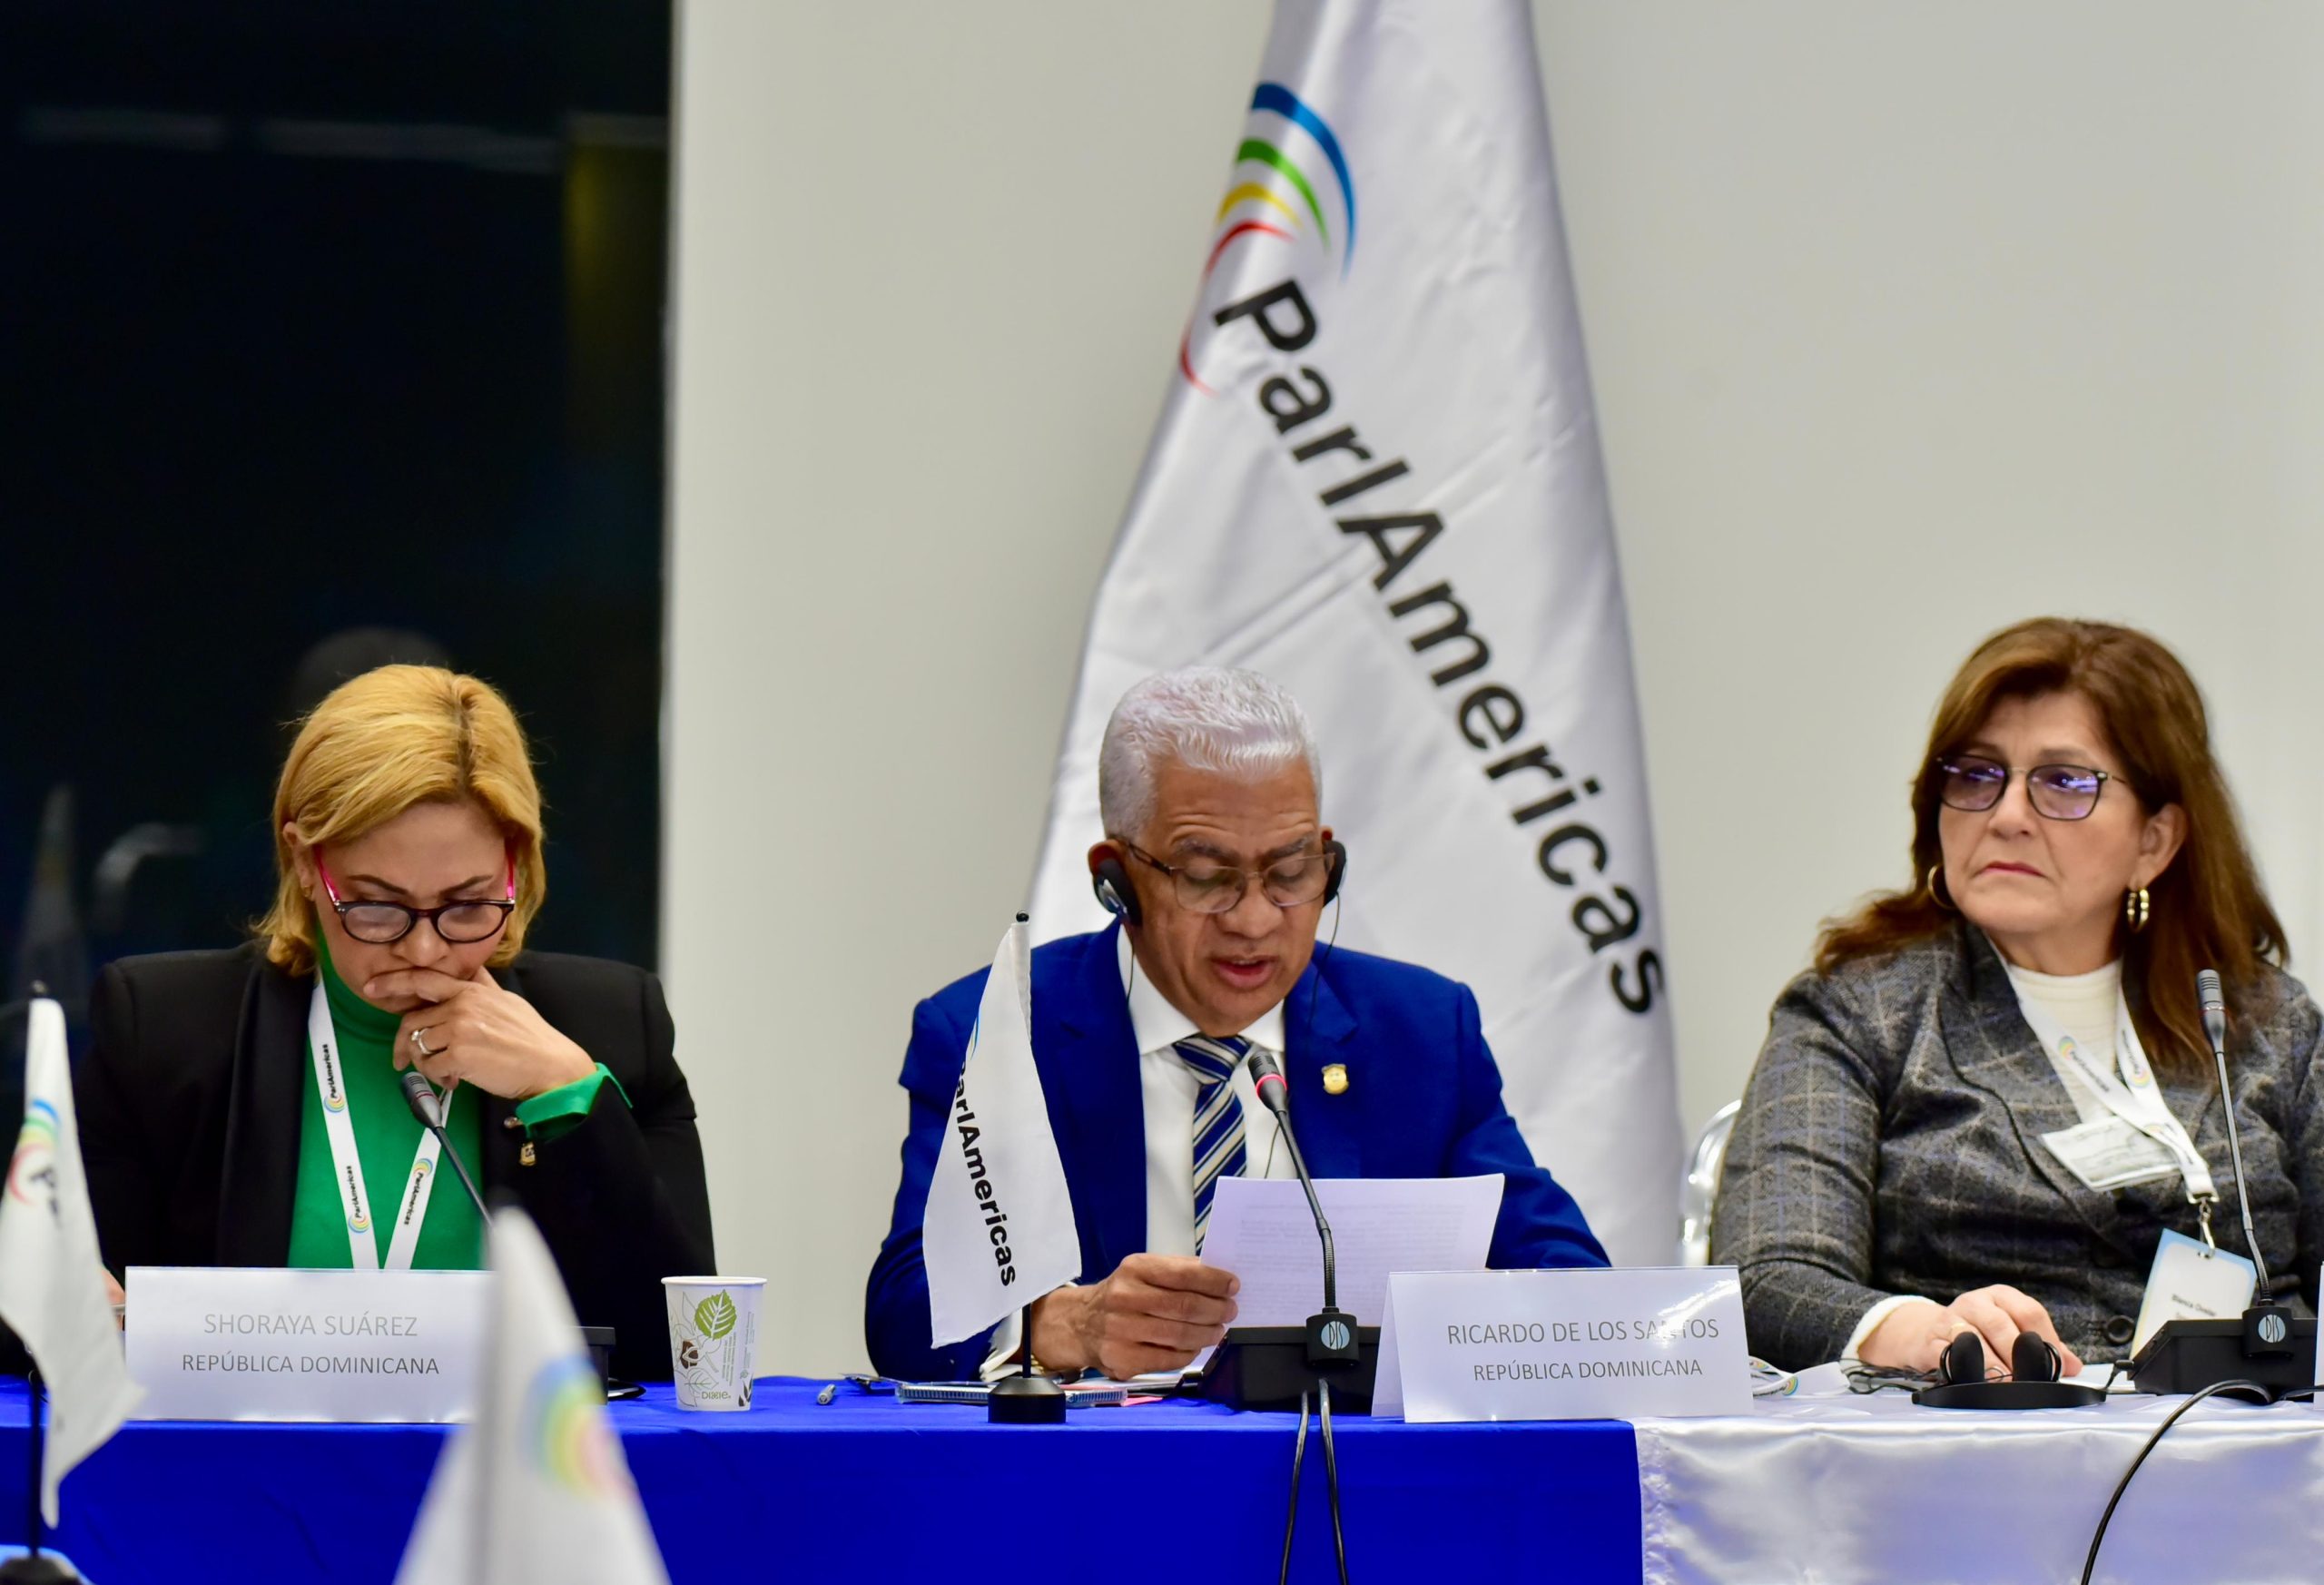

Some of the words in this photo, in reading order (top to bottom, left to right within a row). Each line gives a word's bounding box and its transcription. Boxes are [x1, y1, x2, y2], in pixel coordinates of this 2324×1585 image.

[1214, 278, 1665, 1017] ParlAmericas
[203, 1314, 316, 1335] SHORAYA
[324, 1311, 419, 1337] SUÁREZ
[1447, 1323, 1544, 1344] RICARDO
[1552, 1322, 1581, 1342] DE
[1588, 1321, 1628, 1341] LOS
[182, 1351, 293, 1373] REPÚBLICA
[300, 1355, 439, 1374] DOMINICANA
[1473, 1359, 1573, 1381] REPÚBLICA
[1579, 1359, 1702, 1378] DOMINICANA
